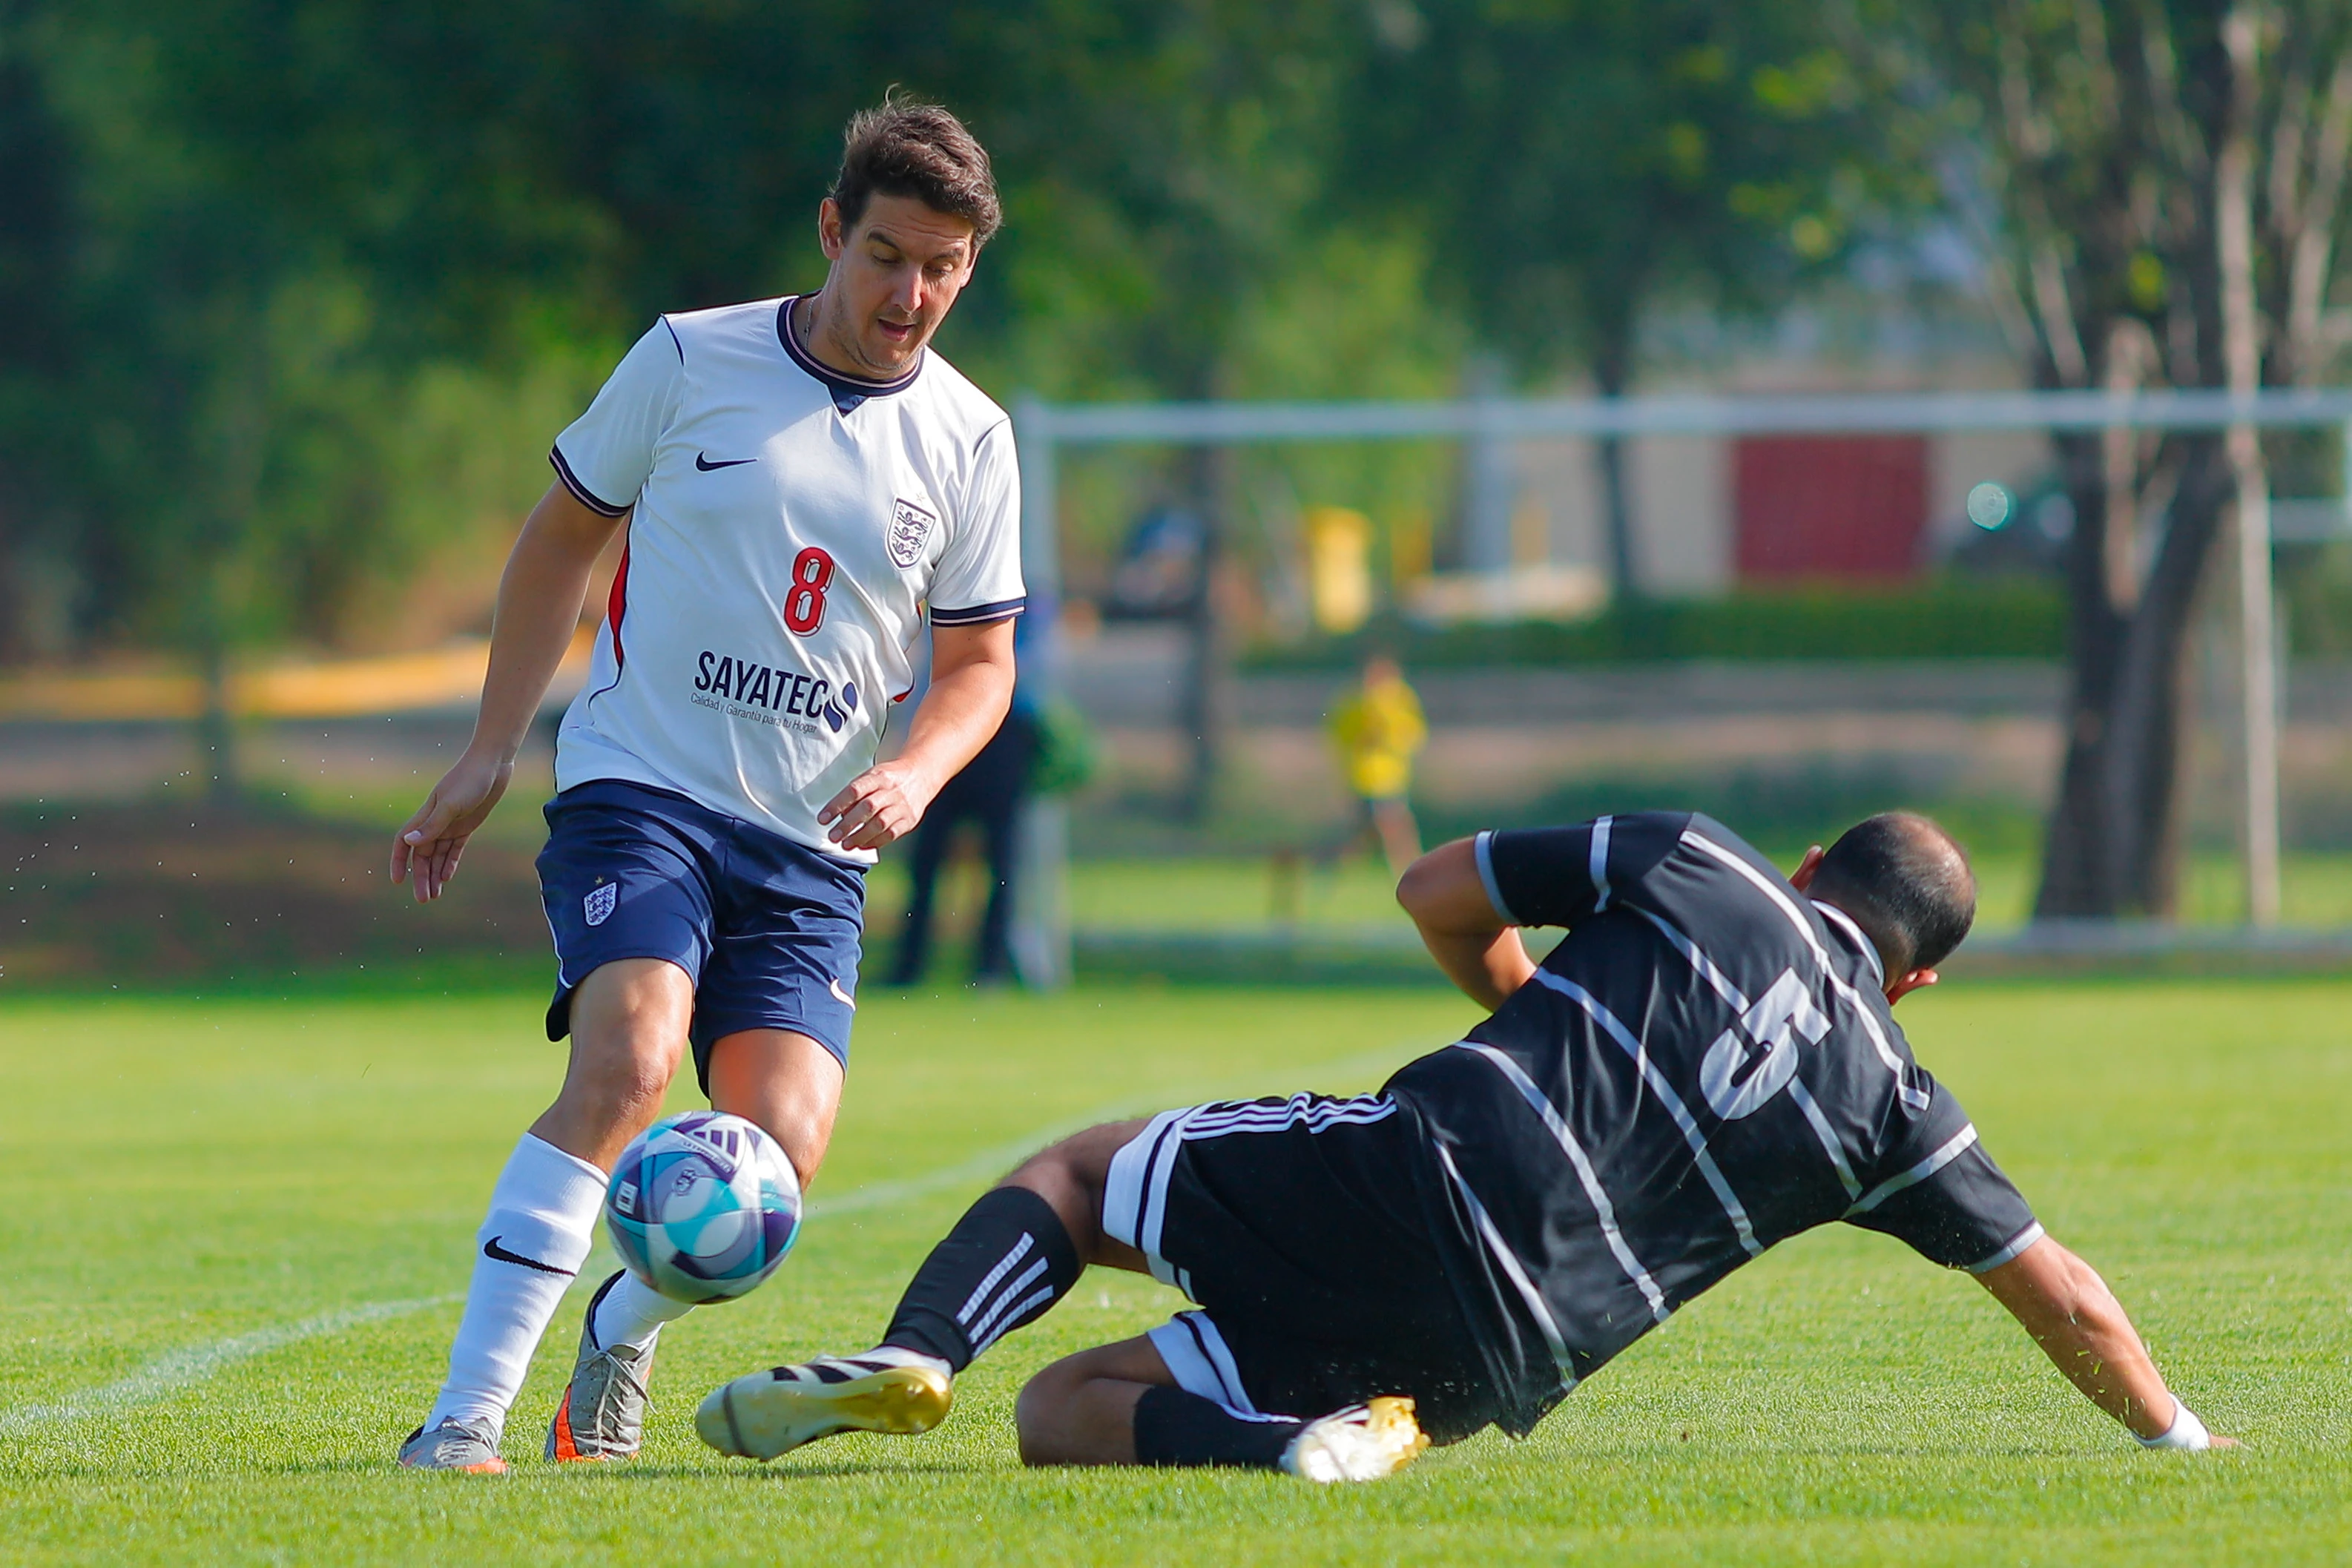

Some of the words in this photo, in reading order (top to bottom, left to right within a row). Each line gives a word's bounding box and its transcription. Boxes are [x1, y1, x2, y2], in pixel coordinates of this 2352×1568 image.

[784, 547, 835, 637] 8
[691, 692, 719, 710] Calidad
[719, 702, 725, 714] y
[762, 715, 781, 726] para
[783, 718, 791, 728] tu
[792, 719, 817, 734] Hogar
[694, 650, 829, 718] SAYATEC
[1699, 966, 1833, 1120] 5
